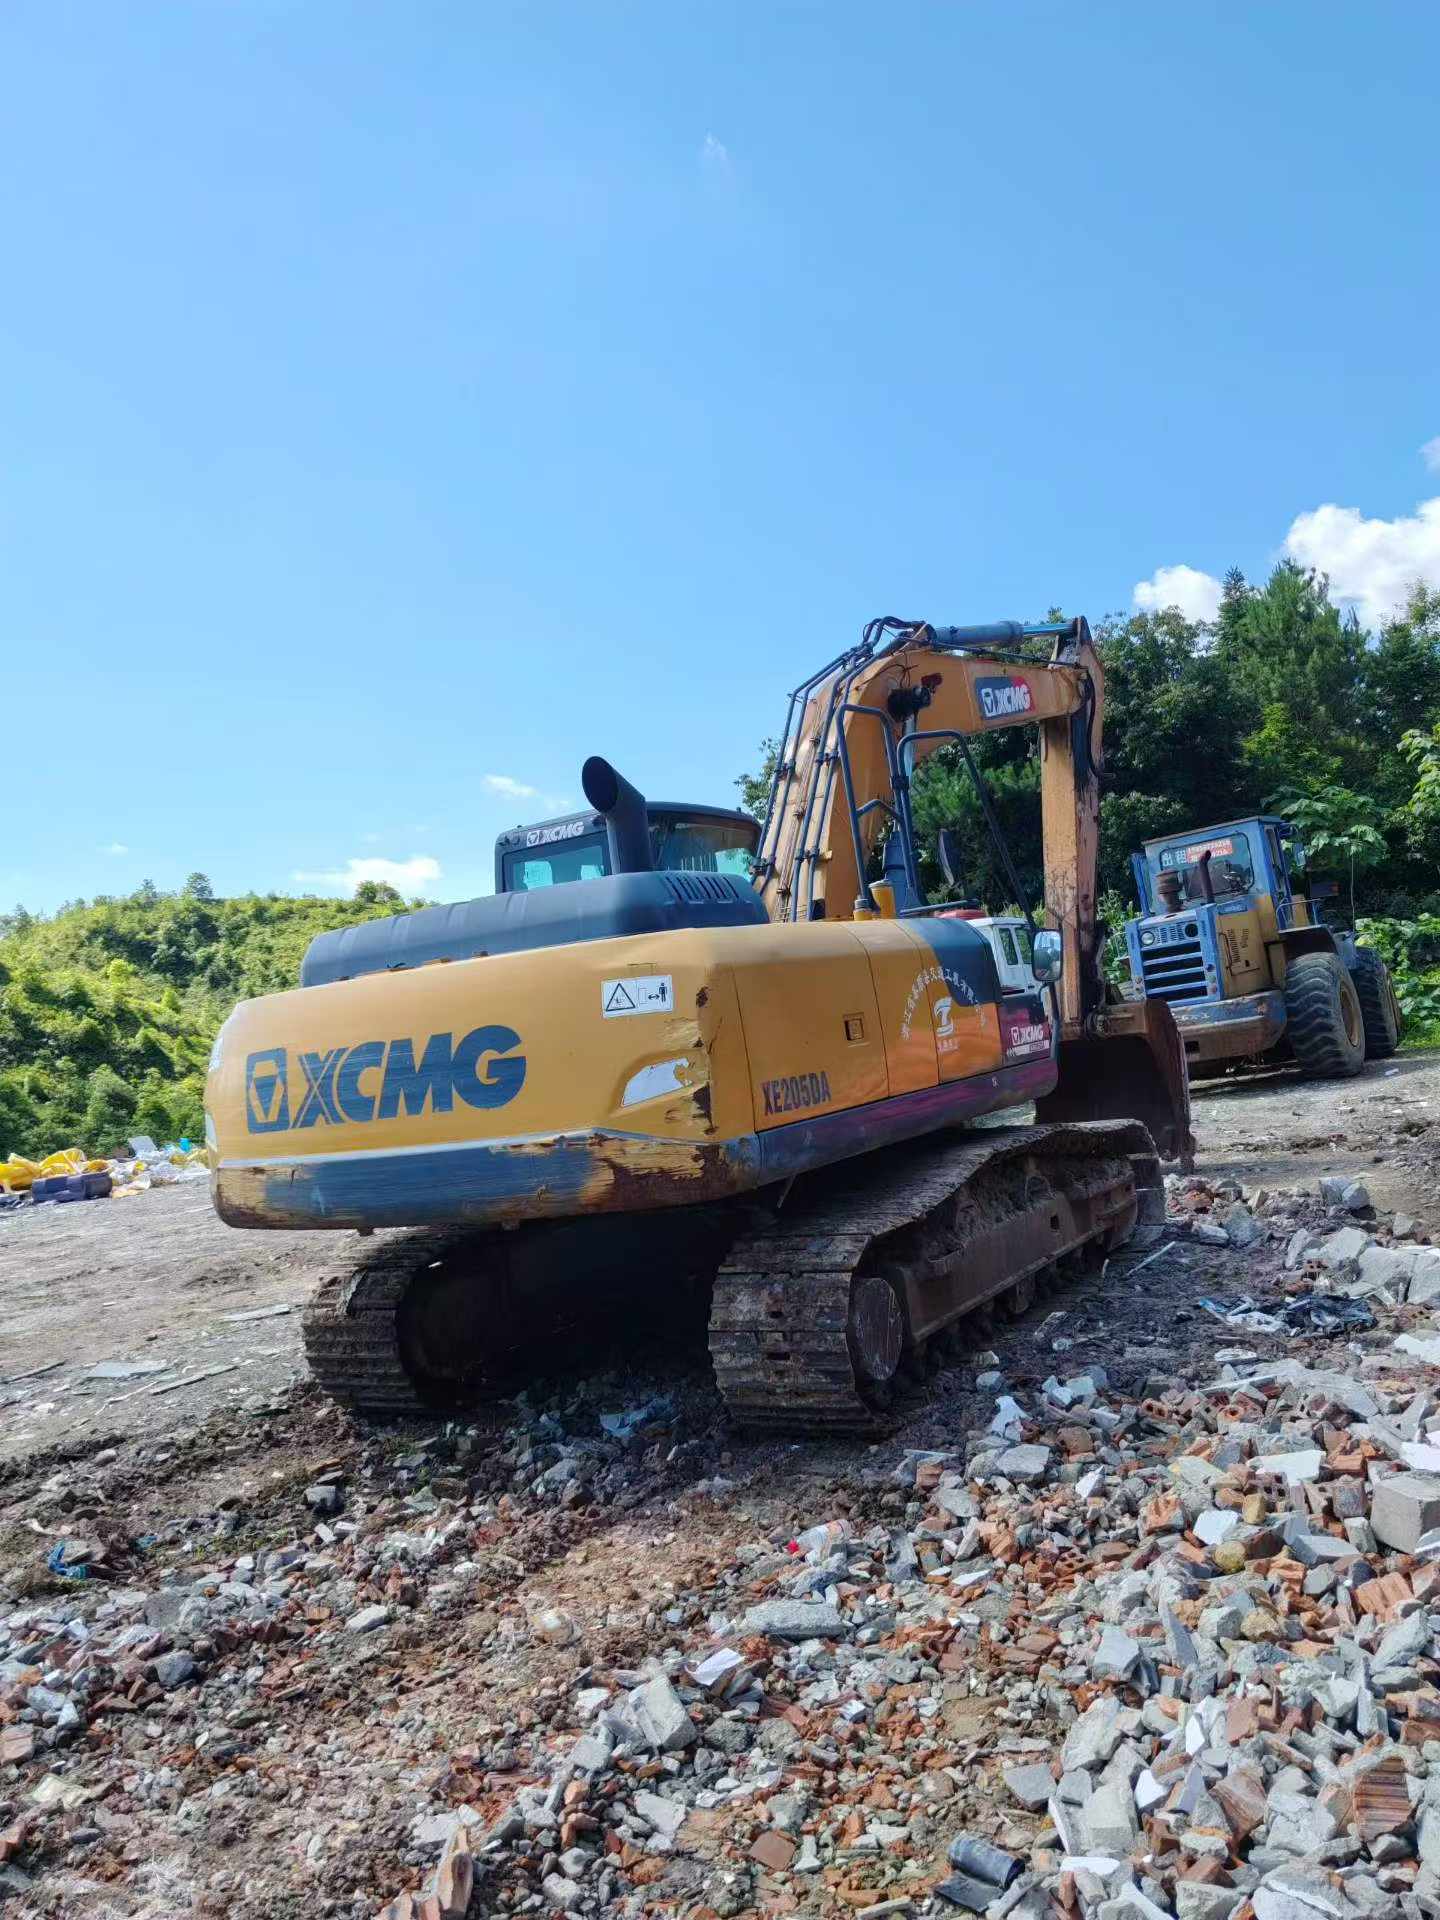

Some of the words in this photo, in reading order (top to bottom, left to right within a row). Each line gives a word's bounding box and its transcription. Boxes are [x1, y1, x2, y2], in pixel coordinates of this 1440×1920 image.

[994, 684, 1030, 713] XCMG
[541, 820, 584, 842] XCMG
[290, 1025, 527, 1129] XCMG
[760, 1071, 832, 1116] XE205DA
